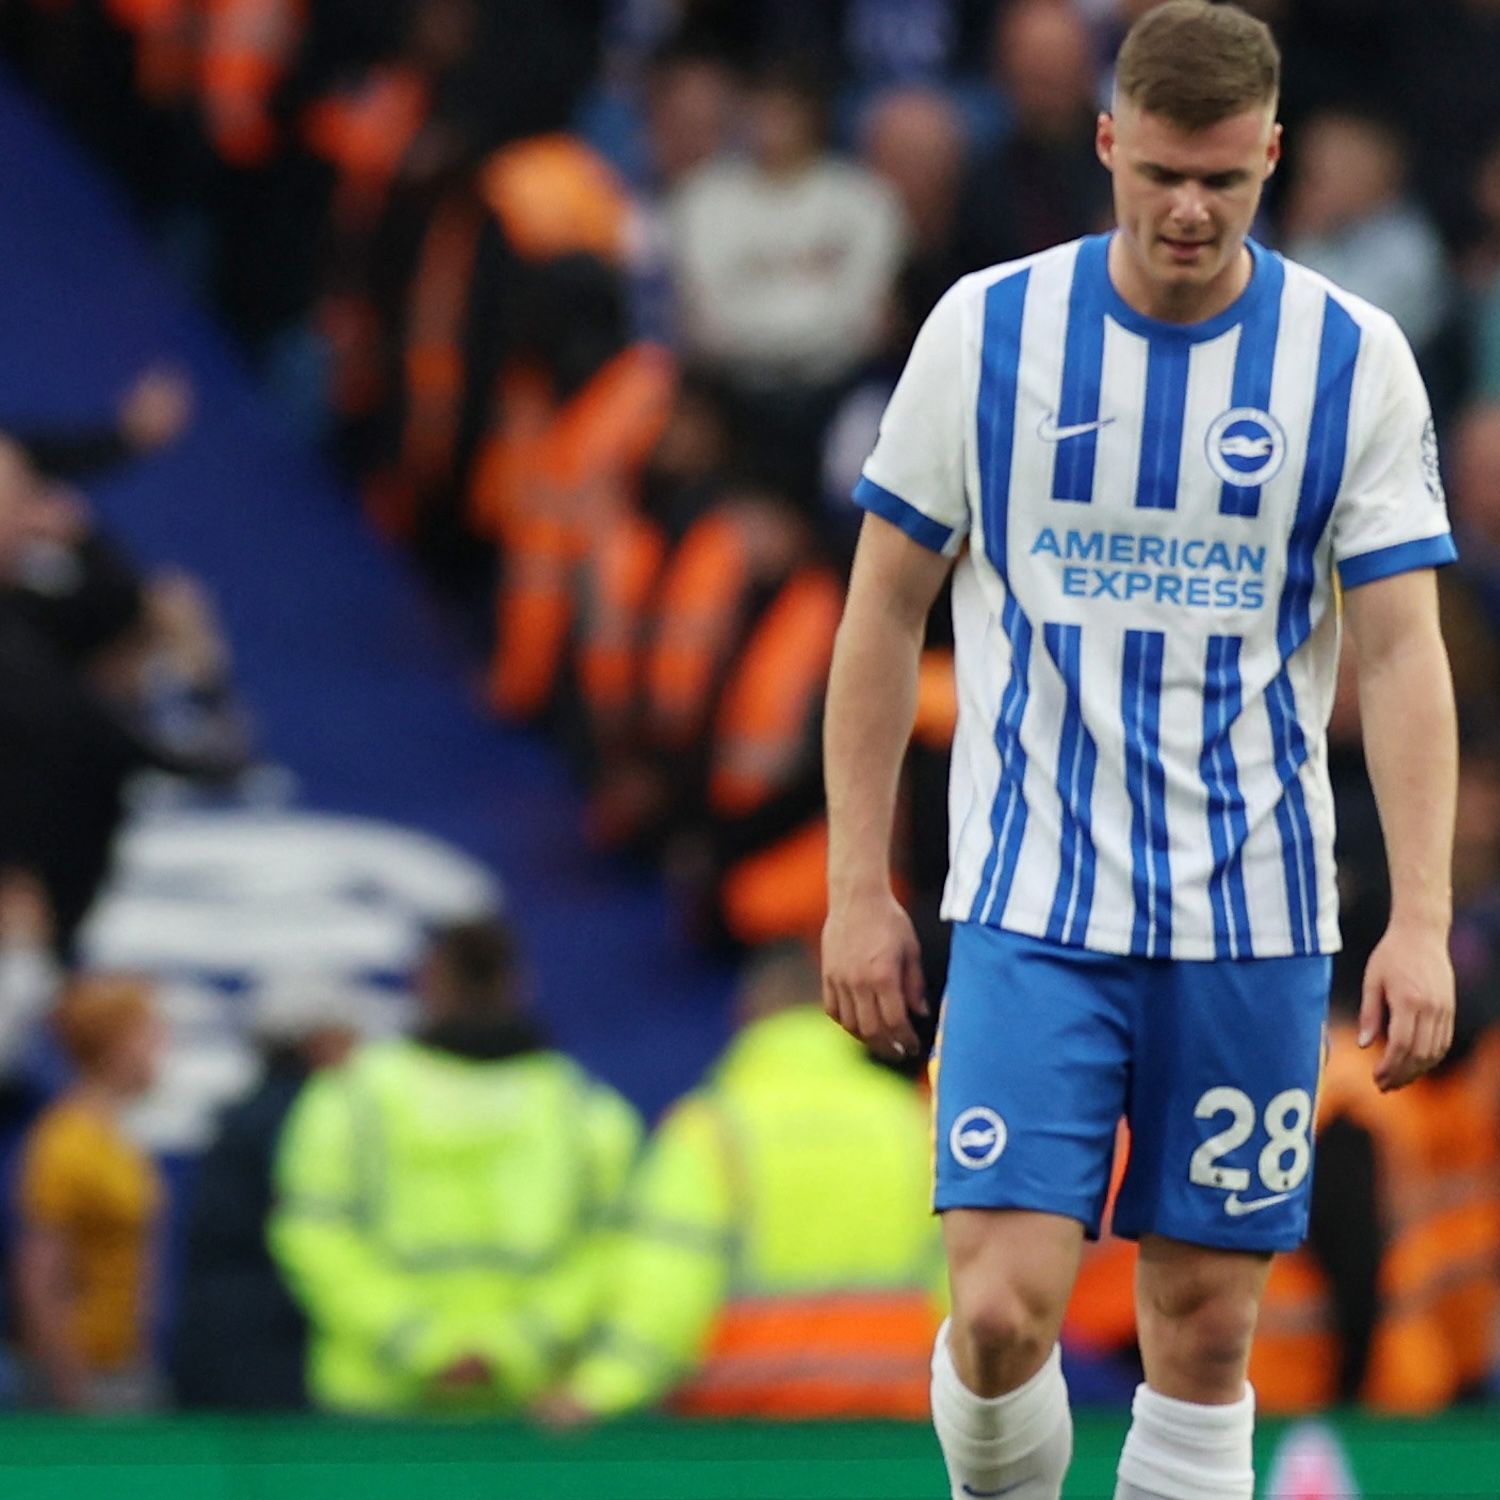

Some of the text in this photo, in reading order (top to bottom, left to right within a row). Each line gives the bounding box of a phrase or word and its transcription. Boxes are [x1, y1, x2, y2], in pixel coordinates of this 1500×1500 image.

[1031, 528, 1266, 573] AMERICAN
[1063, 566, 1266, 609] EXPRESS
[1189, 1085, 1312, 1193] 28
